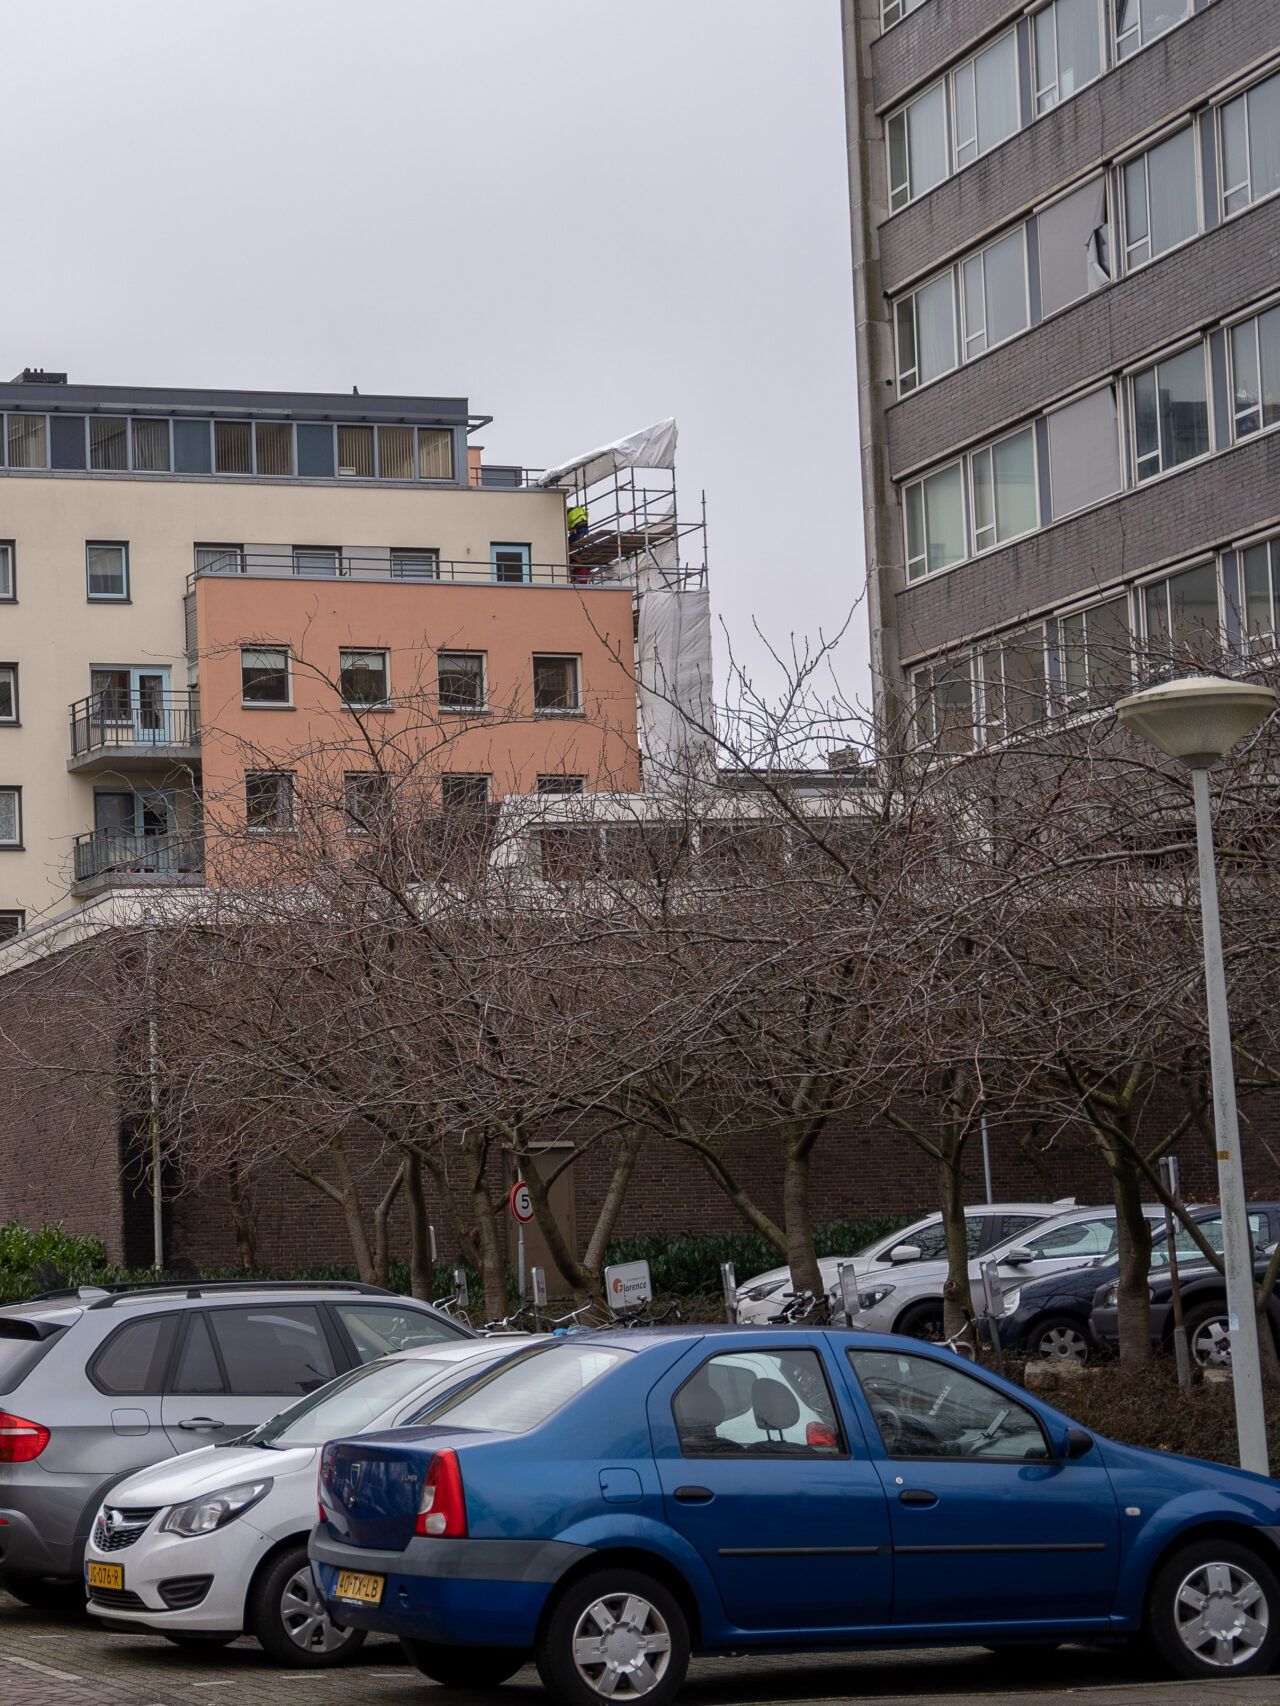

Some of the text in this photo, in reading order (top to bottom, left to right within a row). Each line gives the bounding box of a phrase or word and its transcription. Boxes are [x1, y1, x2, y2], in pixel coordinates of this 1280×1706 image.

[522, 1194, 530, 1209] 5
[617, 1281, 647, 1294] Florence
[89, 1564, 119, 1587] JG-076-R
[339, 1574, 379, 1598] 40-TX-LB
